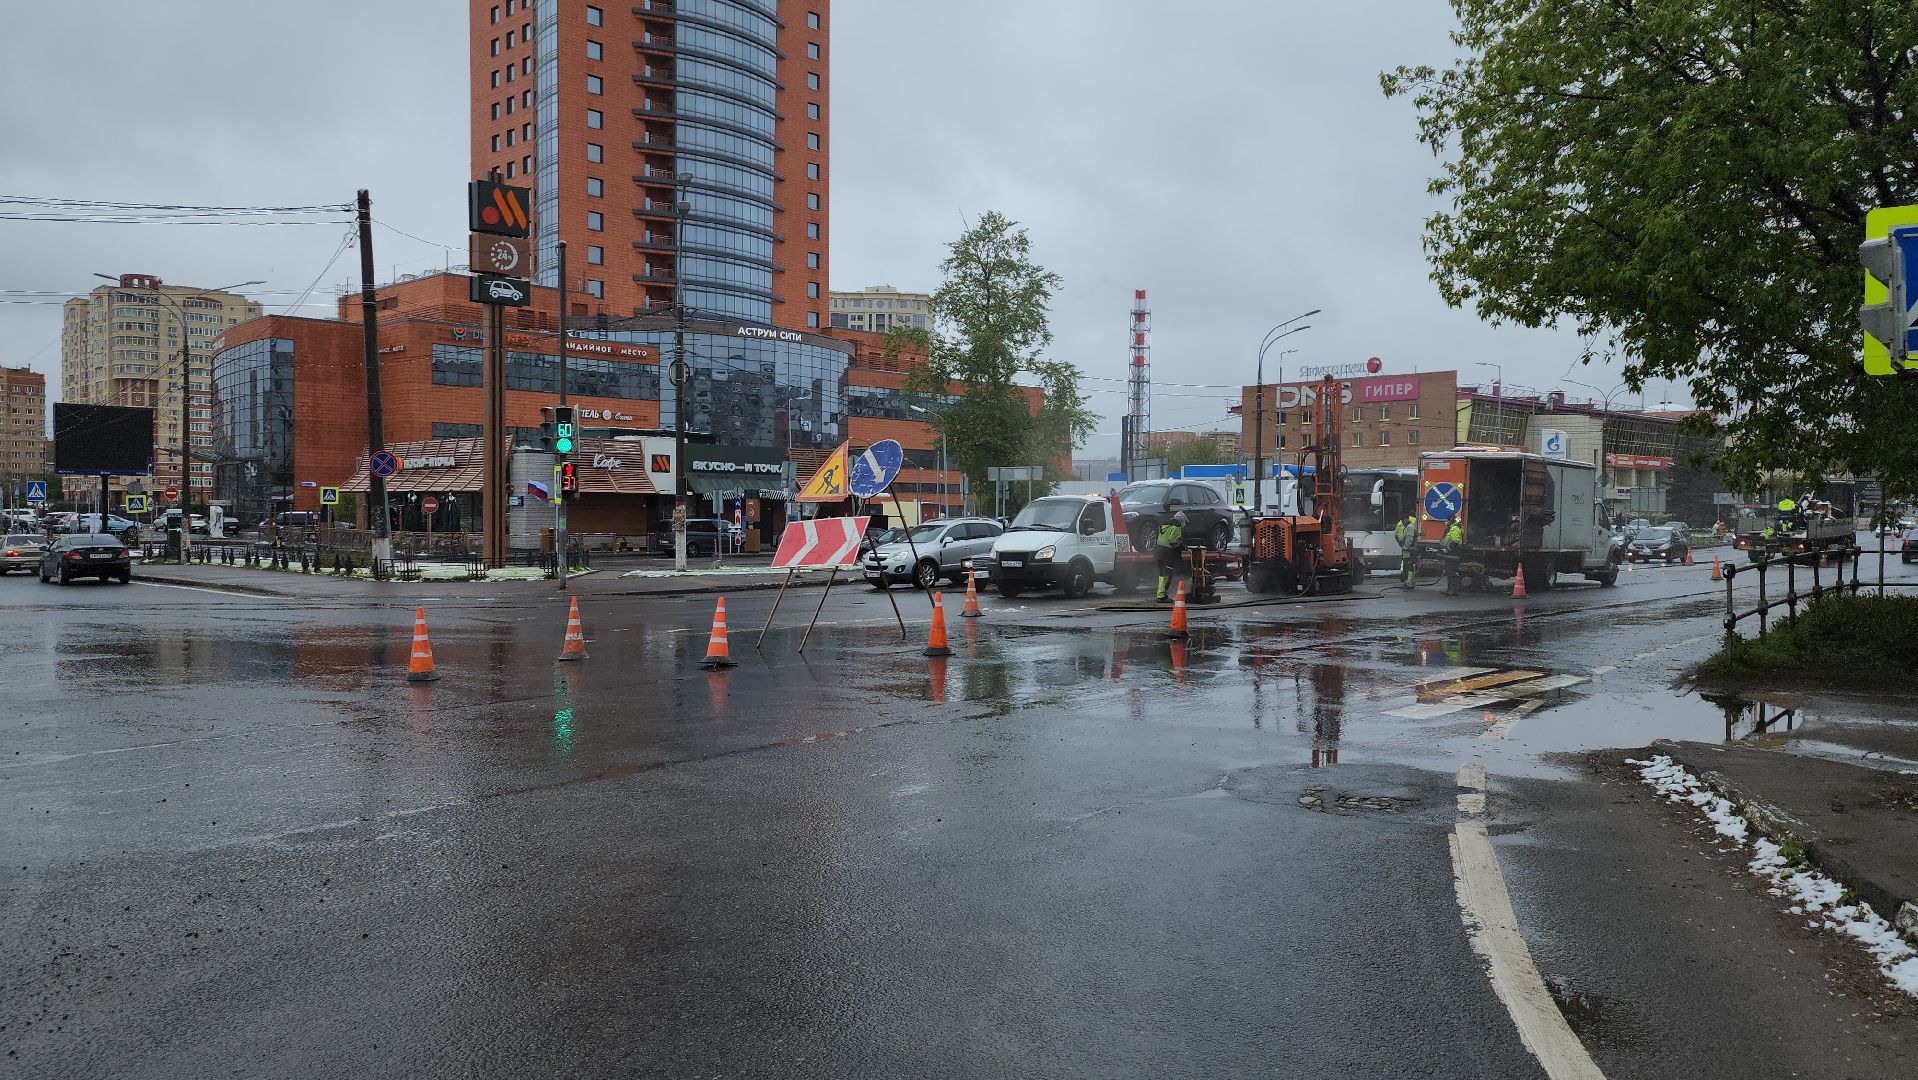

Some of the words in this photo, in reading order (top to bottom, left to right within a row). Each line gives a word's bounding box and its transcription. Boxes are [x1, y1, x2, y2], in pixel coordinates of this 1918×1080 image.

[737, 326, 777, 339] АСТРУМ
[779, 331, 802, 342] СИТИ
[621, 348, 647, 357] МЕСТО
[1365, 382, 1414, 398] ГИПЕР
[580, 410, 600, 419] ТЕЛЬ
[557, 423, 572, 437] 60
[593, 453, 622, 471] Кафе
[753, 463, 783, 473] ТОЧК
